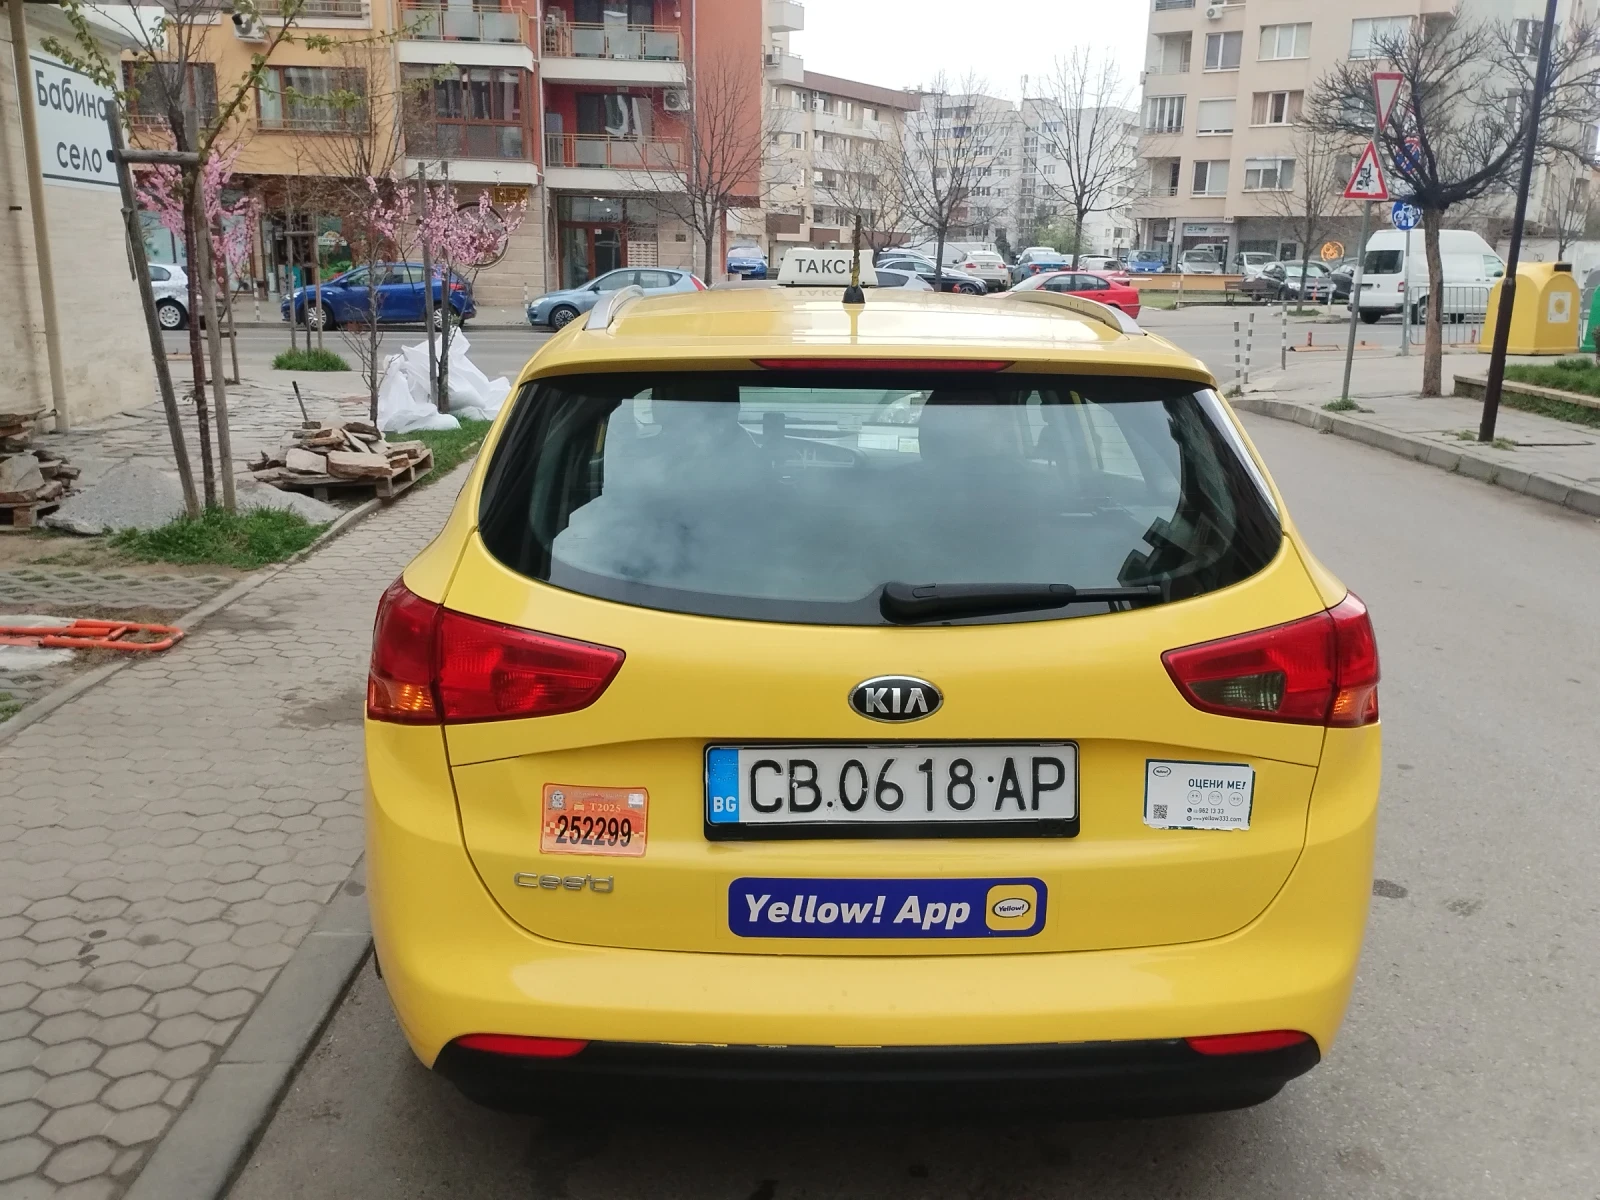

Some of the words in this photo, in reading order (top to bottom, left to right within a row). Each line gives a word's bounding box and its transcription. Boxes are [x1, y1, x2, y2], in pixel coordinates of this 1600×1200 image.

[56, 141, 102, 173] село
[865, 687, 929, 713] KIA
[1188, 778, 1224, 789] ОЦЕНИ
[1226, 780, 1247, 790] МЕ!
[589, 802, 622, 813] T2025
[713, 796, 737, 812] BG
[555, 814, 632, 847] 252299
[513, 871, 615, 894] cee'd
[744, 893, 886, 924] Yellow!
[892, 895, 971, 930] App
[998, 903, 1025, 912] Yellow!
